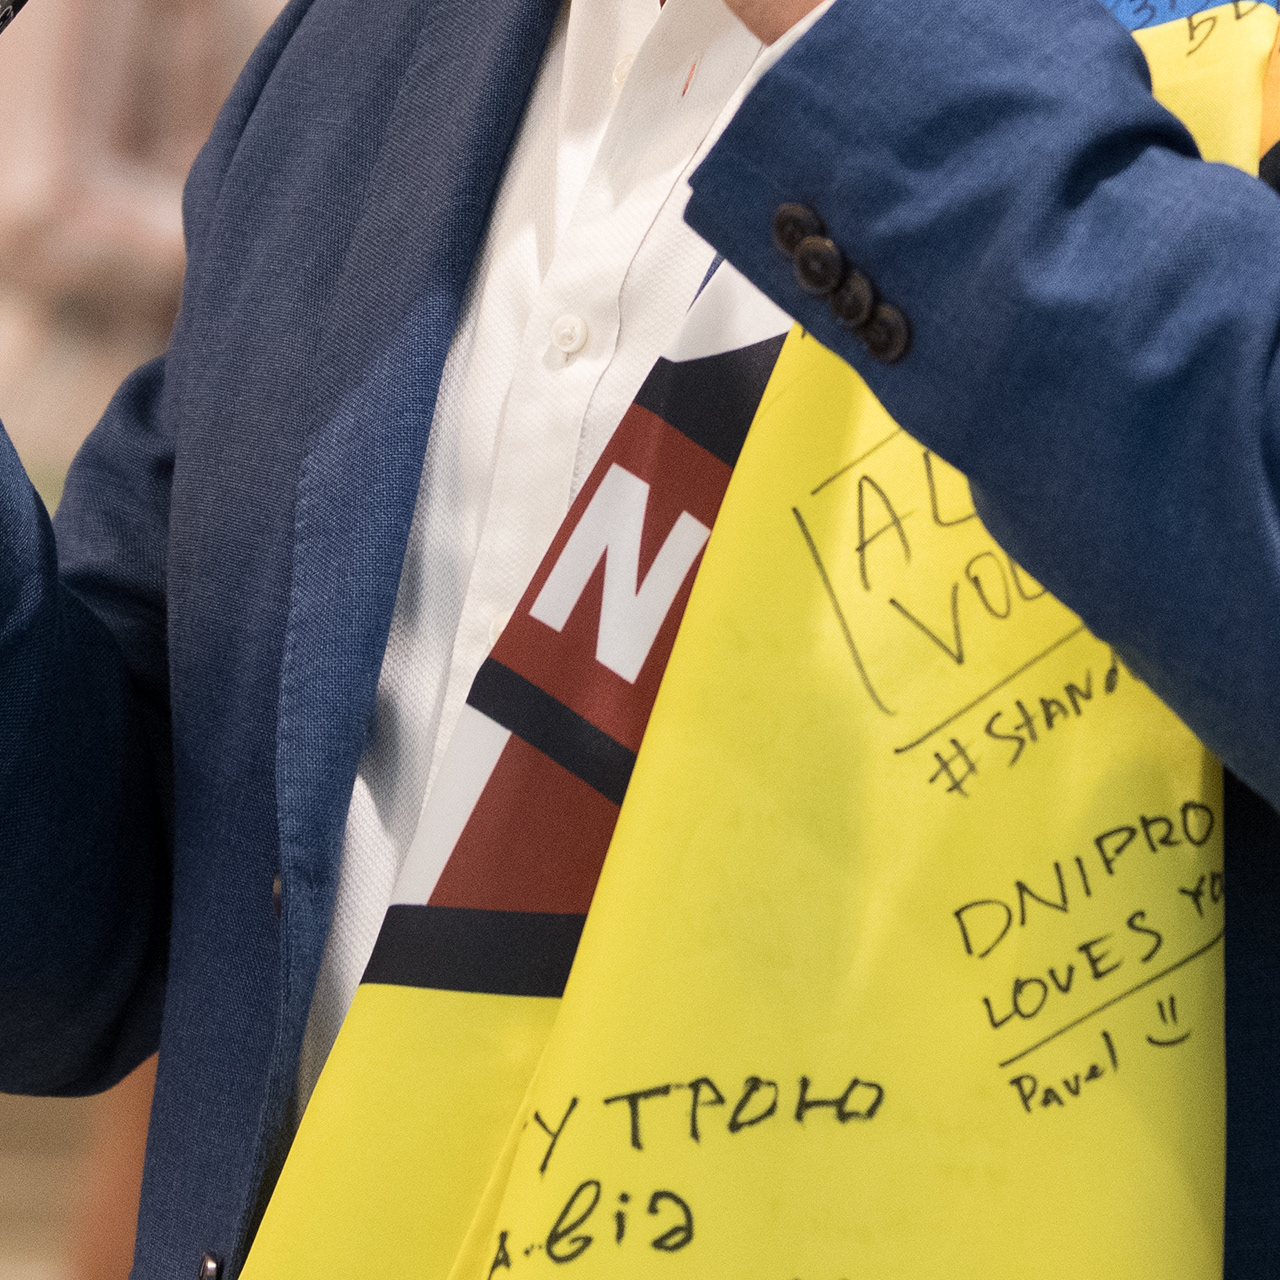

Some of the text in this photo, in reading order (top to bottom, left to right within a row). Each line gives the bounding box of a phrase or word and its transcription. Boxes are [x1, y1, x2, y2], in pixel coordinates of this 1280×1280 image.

[528, 462, 712, 684] N
[954, 799, 1215, 959] DNIPRO
[982, 909, 1165, 1030] LOVES
